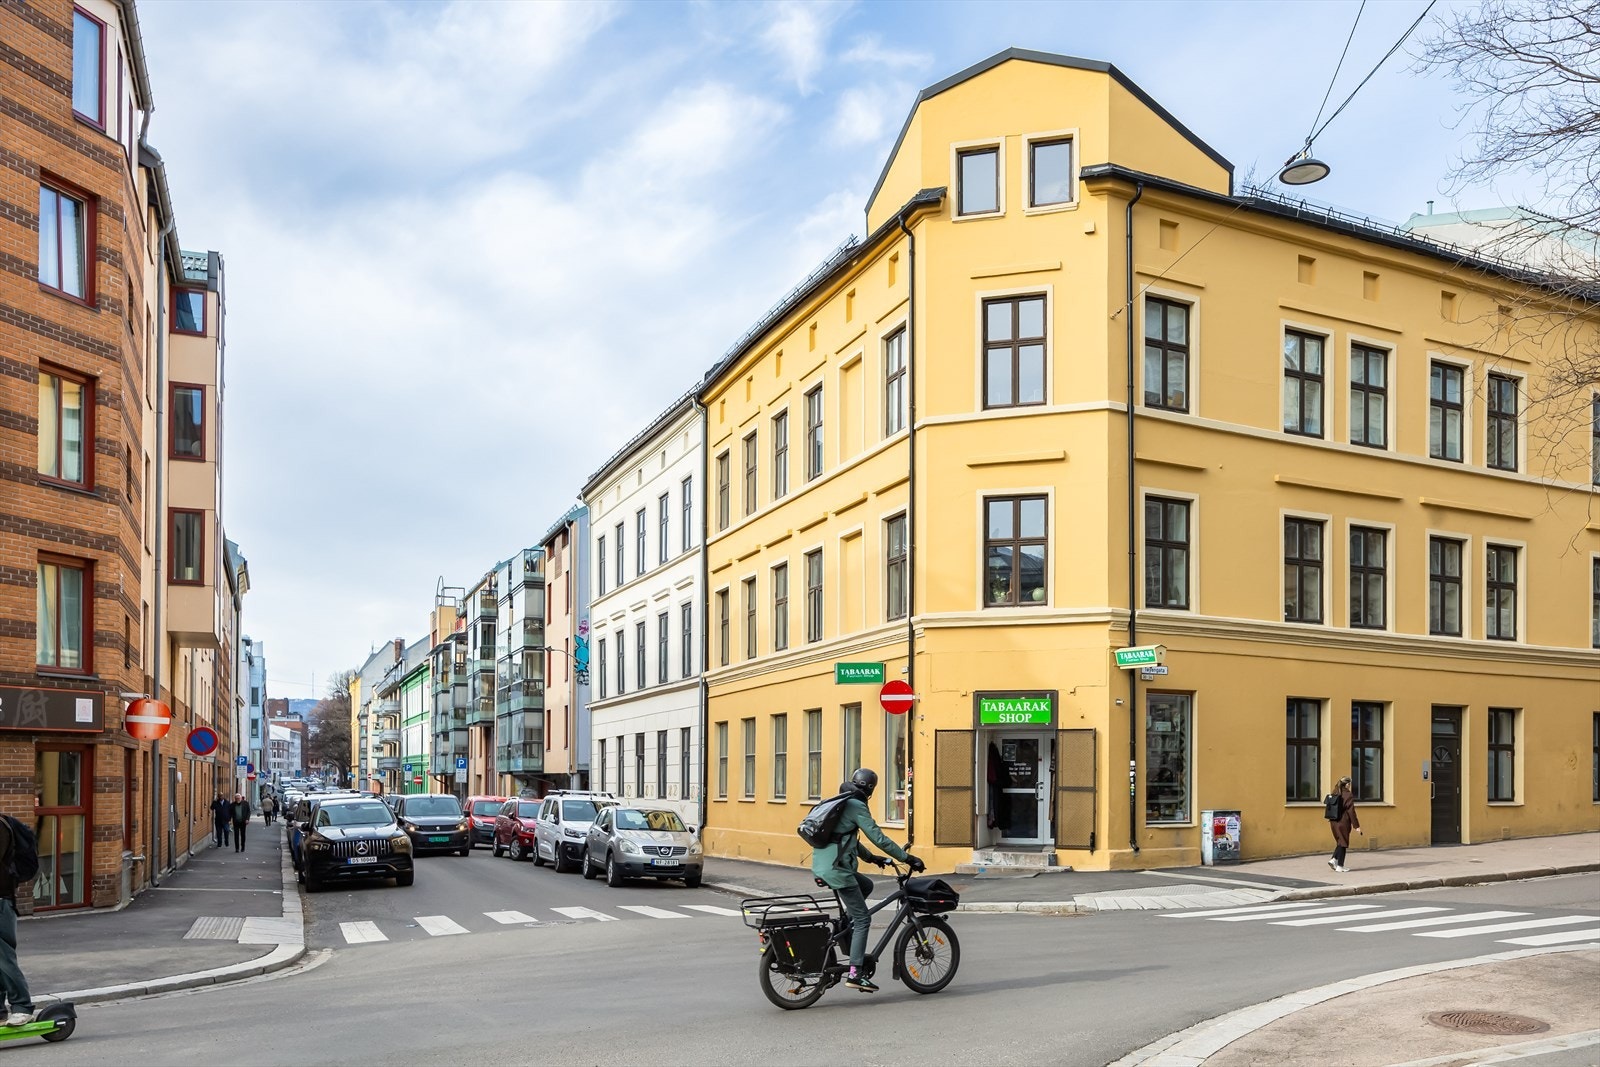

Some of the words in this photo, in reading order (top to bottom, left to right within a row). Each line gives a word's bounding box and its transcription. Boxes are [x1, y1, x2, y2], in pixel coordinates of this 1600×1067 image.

[1120, 650, 1154, 660] TABAARAK
[982, 701, 1049, 712] TABAARAK
[998, 713, 1032, 723] SHOP
[458, 759, 465, 768] P
